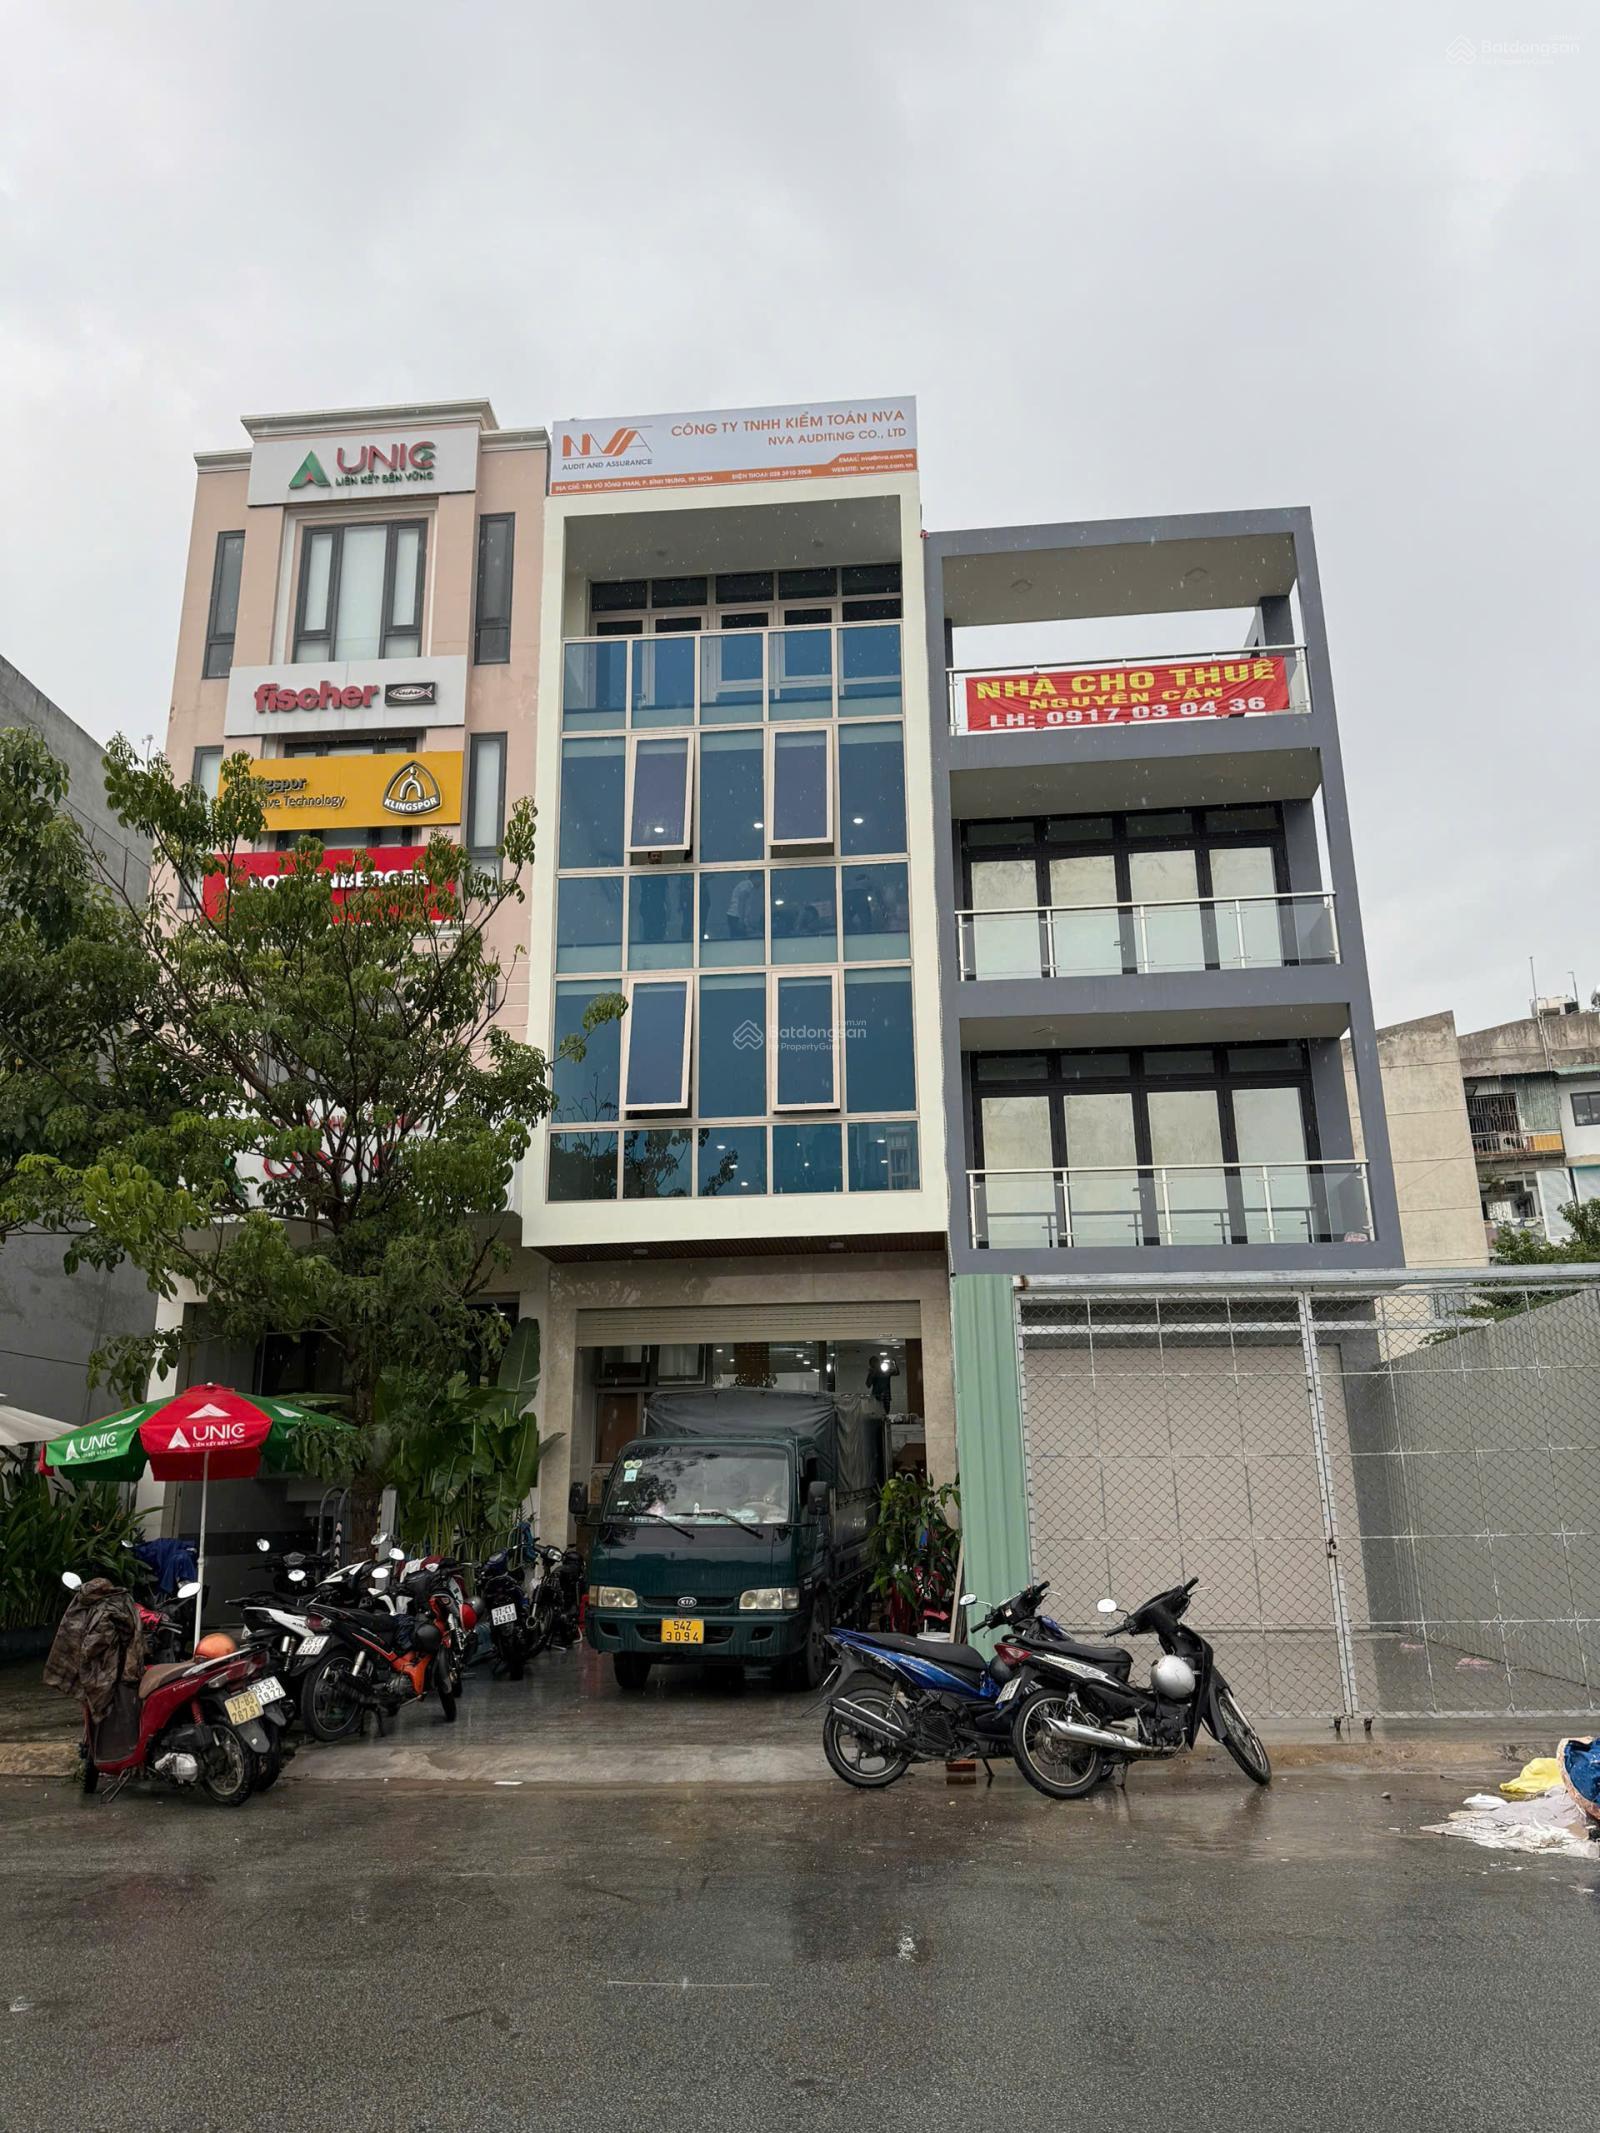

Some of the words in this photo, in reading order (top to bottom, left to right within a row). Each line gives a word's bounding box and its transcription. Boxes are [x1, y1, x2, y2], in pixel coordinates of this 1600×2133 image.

[671, 422, 717, 437] CÔNG
[721, 422, 738, 433] TY
[743, 418, 780, 431] TNHH
[785, 412, 823, 428] KIỂM
[827, 410, 867, 426] TOÁN
[872, 409, 905, 422] NVA
[768, 436, 794, 446] NVA
[799, 431, 855, 444] AUDITING
[858, 429, 884, 440] CO.,
[887, 427, 906, 438] LTD
[562, 463, 584, 471] AUDIT
[586, 461, 604, 469] AND
[606, 458, 653, 467] ASSURANCE
[335, 475, 358, 487] LIÊN
[360, 471, 380, 485] KẾT
[404, 469, 434, 481] VỮNG
[976, 674, 1057, 700] NHÀ
[1071, 671, 1155, 694] CHO
[1169, 659, 1276, 688] THUÊ
[254, 680, 380, 714] fischer
[1028, 691, 1150, 711] NGUYÊN
[989, 712, 1036, 729] LH:
[1045, 706, 1119, 727] 0917
[1132, 703, 1169, 719] 03
[1179, 700, 1216, 716] 04
[1228, 696, 1267, 712] 36
[283, 794, 345, 809] Technology
[384, 796, 438, 811] KLINGSPOR
